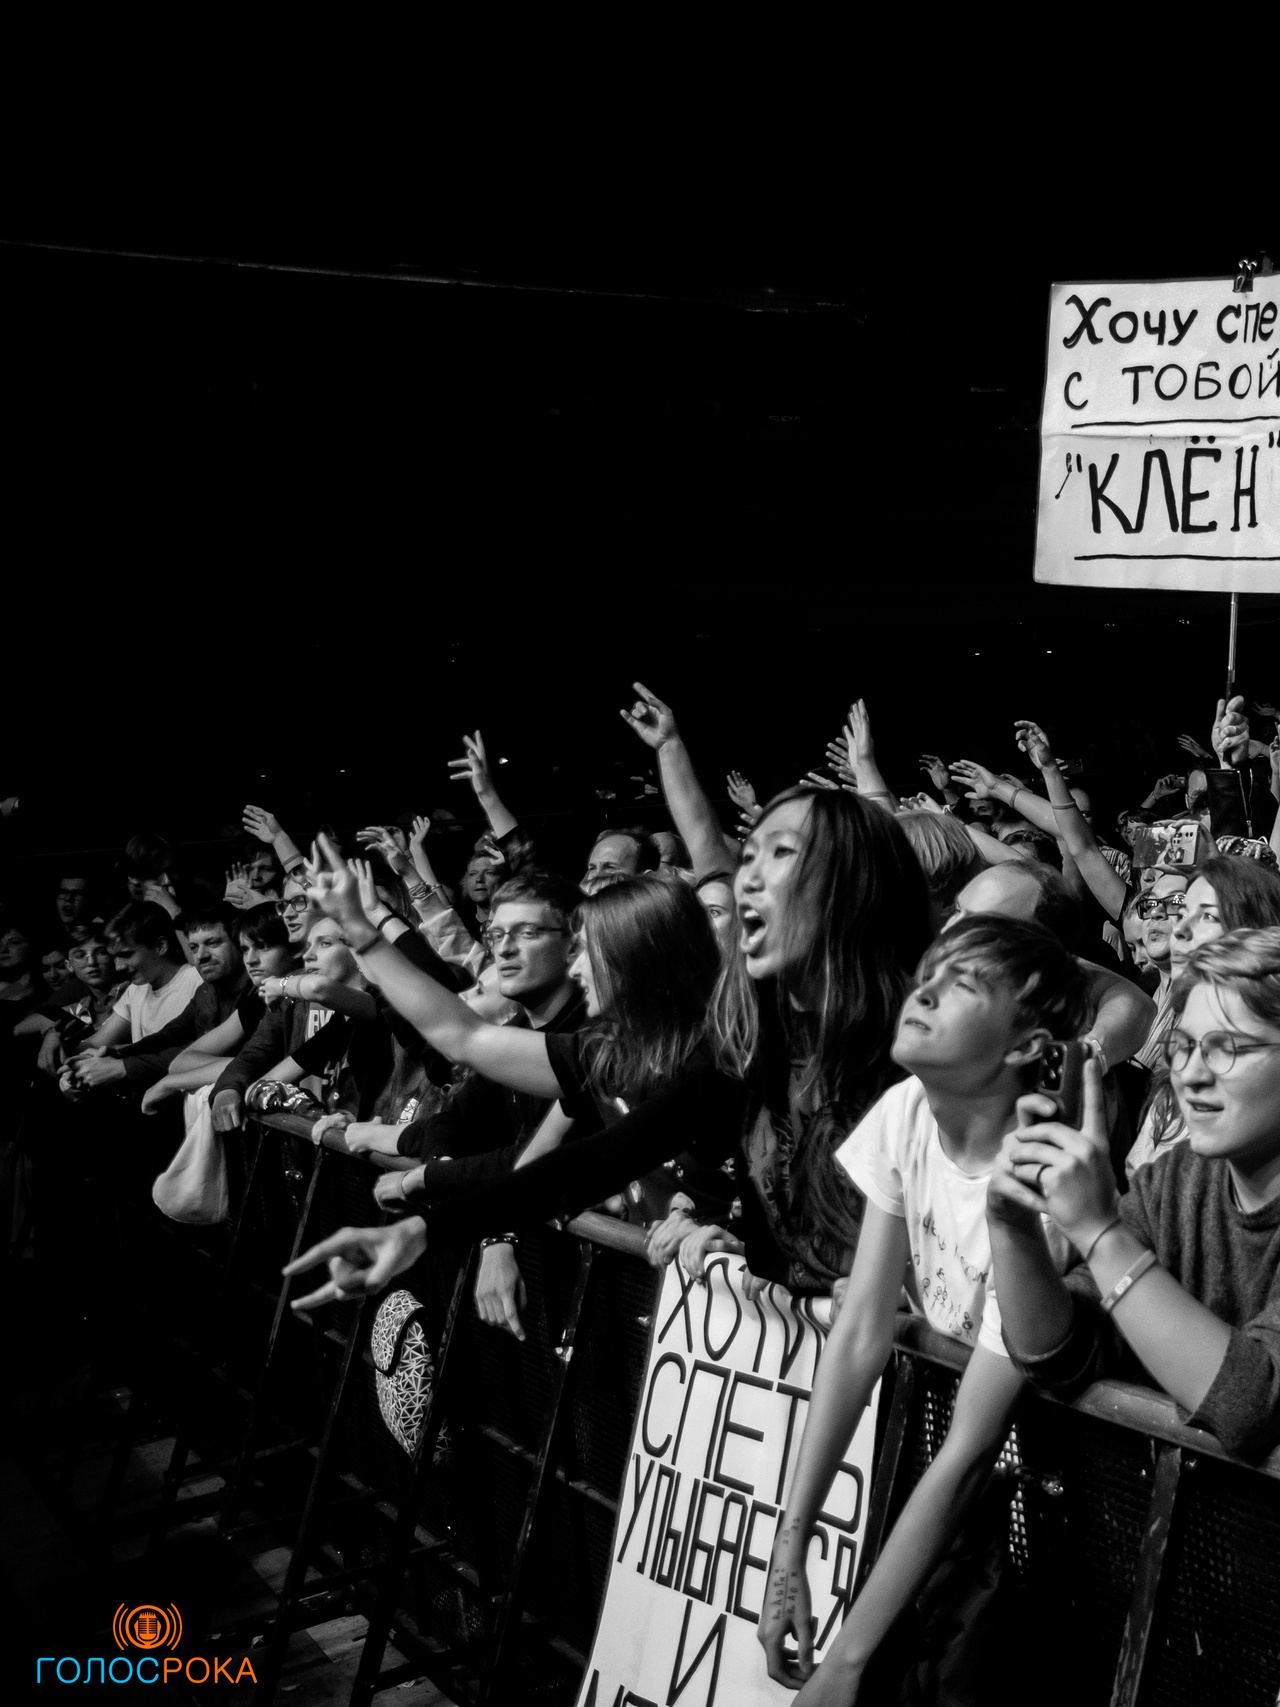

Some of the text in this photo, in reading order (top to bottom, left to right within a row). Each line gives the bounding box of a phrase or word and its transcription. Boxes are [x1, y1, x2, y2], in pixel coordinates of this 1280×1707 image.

[1063, 294, 1198, 348] Хочу
[658, 1256, 870, 1406] ХОТИ
[617, 1453, 857, 1651] УЛЫБАЕСЯ
[665, 1598, 727, 1707] И
